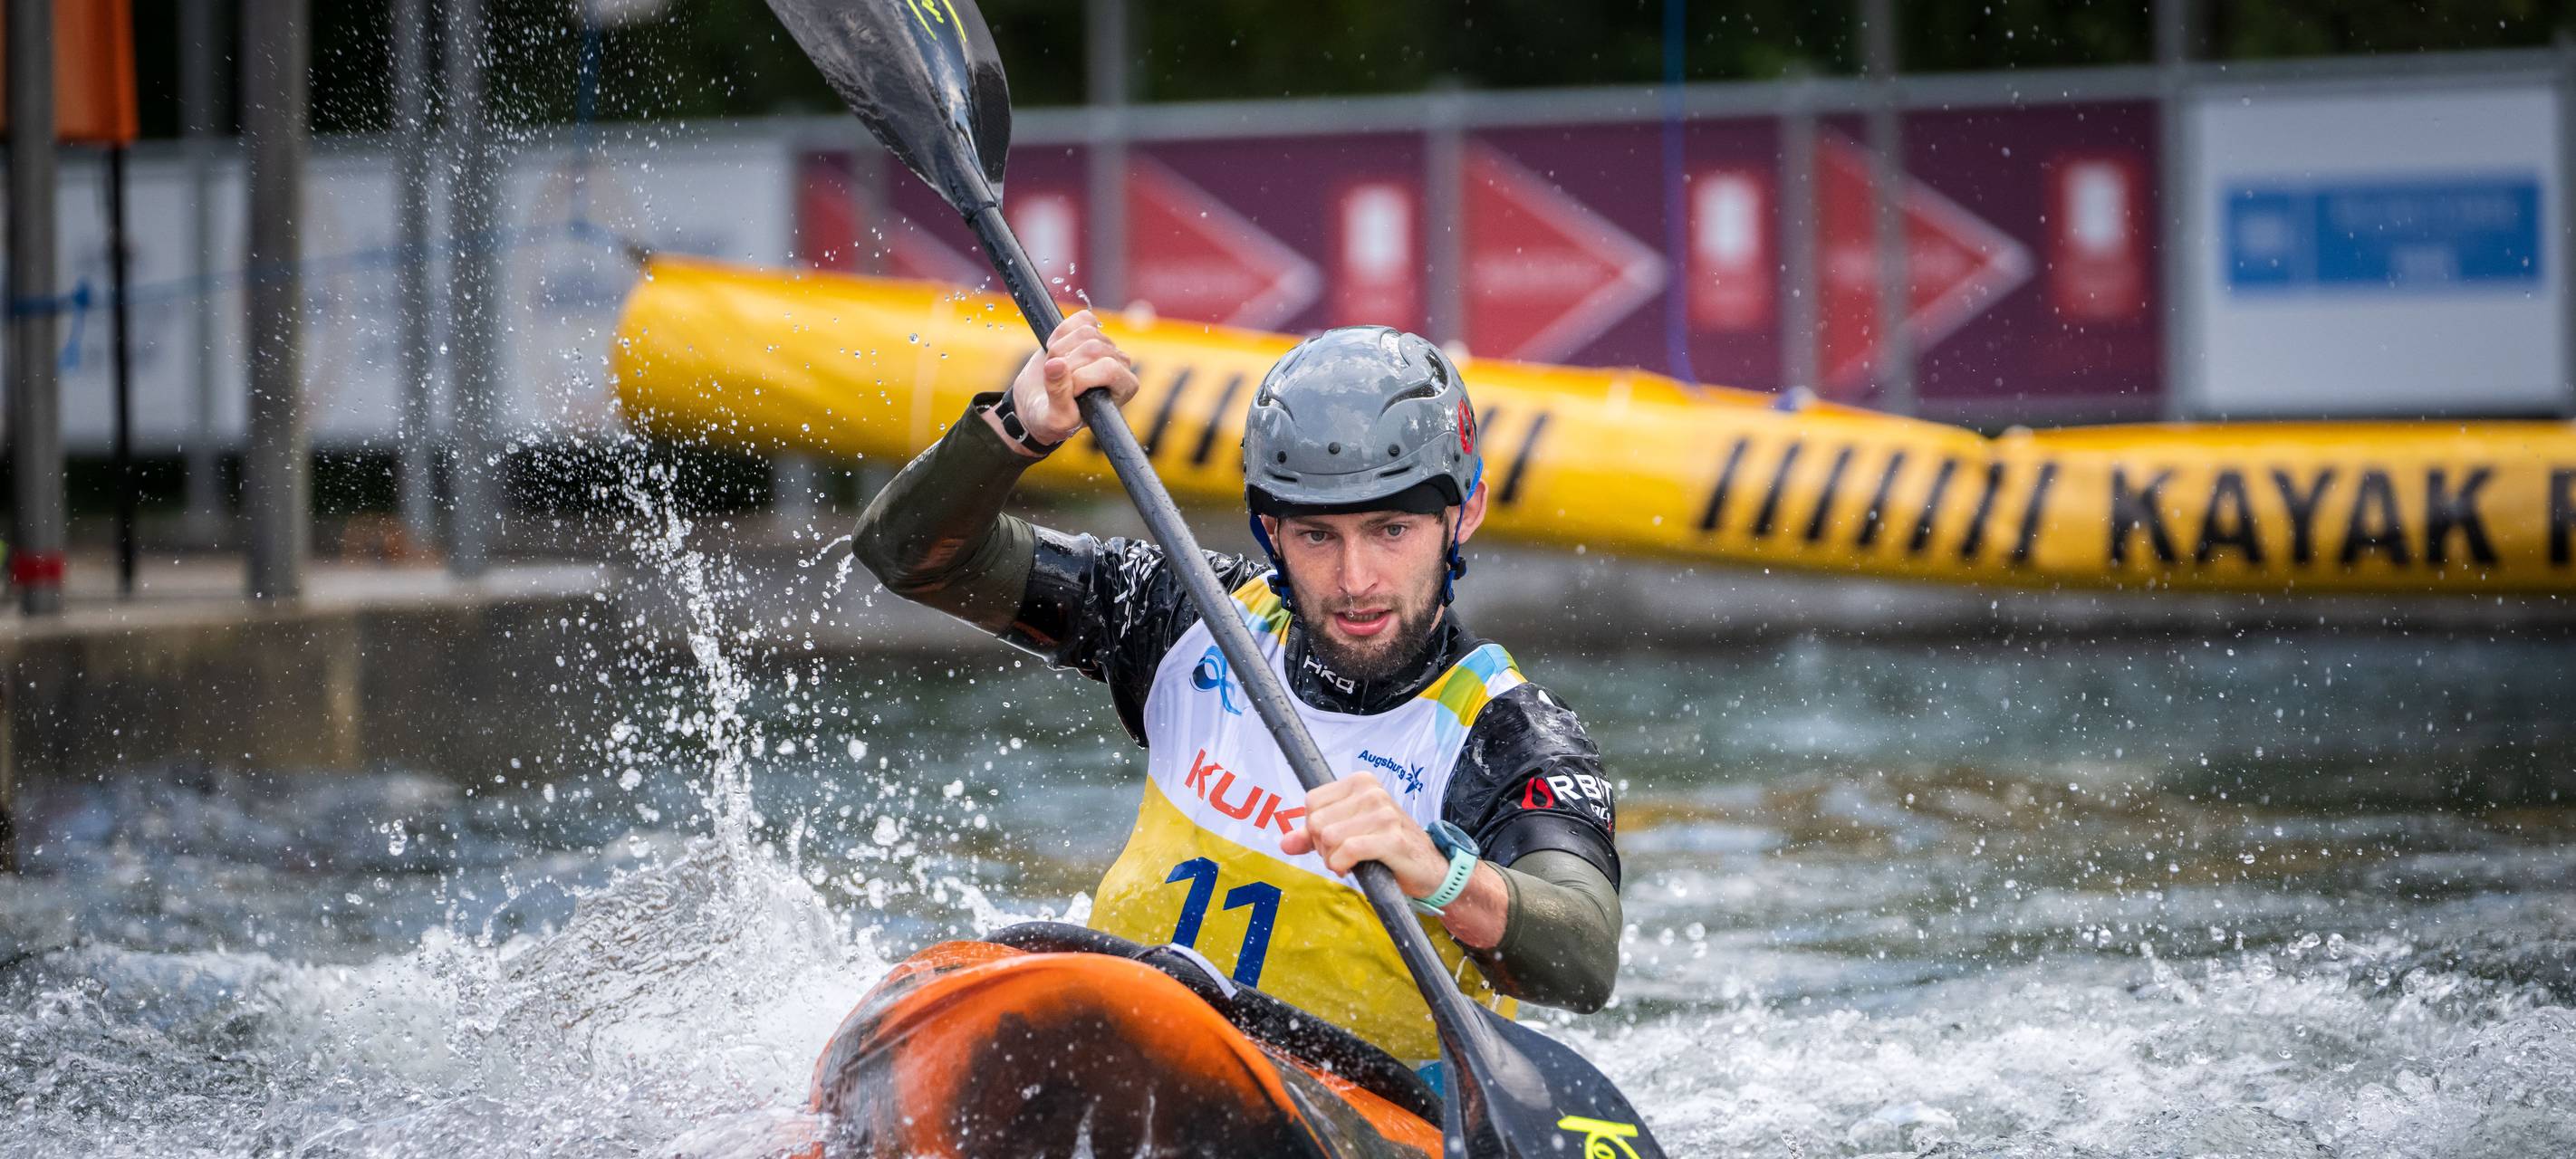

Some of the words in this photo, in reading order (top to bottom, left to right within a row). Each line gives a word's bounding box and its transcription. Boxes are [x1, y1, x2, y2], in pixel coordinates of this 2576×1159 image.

[2107, 465, 2502, 567] KAYAK
[1184, 748, 1306, 835] KUK
[1358, 749, 1407, 781] Augsburg
[1165, 856, 1283, 989] 11
